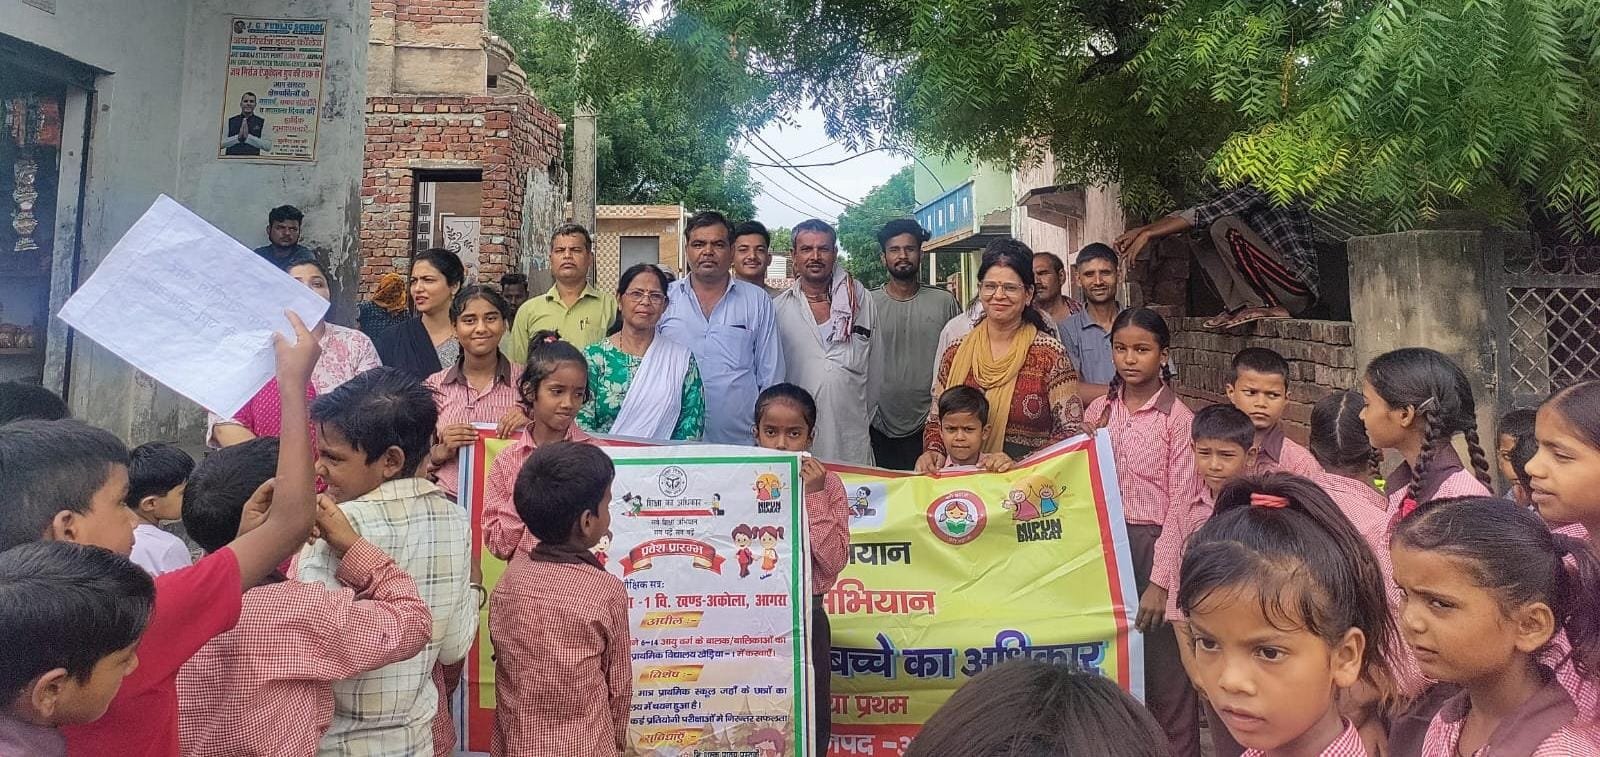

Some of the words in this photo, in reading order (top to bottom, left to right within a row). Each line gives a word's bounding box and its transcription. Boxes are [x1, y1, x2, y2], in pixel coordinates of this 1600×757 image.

[265, 22, 294, 31] PUBLIC
[295, 23, 324, 33] SCHOOL
[293, 67, 300, 78] की
[301, 89, 310, 97] को
[647, 498, 661, 507] शिक्षा
[677, 497, 701, 507] अधिकार
[758, 501, 781, 510] NIPUN
[1016, 519, 1062, 538] NIPUN
[1017, 531, 1062, 543] BHARAT
[641, 542, 666, 556] प्रवेश
[655, 592, 671, 608] वि.
[755, 594, 788, 607] आगरा
[647, 615, 682, 626] अपील
[660, 638, 677, 648] आयु
[679, 636, 693, 645] वर्ग
[695, 636, 704, 644] के
[631, 650, 664, 661] प्राथमिक
[665, 649, 696, 659] विद्यालय
[902, 648, 953, 677] का
[650, 670, 680, 678] विशेष
[658, 687, 690, 697] प्राथमिक
[695, 688, 716, 698] स्कूल
[720, 685, 737, 696] जहाँ
[741, 685, 750, 694] के
[754, 685, 772, 695] छात्रों
[644, 702, 652, 710] में
[673, 702, 689, 713] हुआ
[856, 695, 909, 718] प्रथम
[646, 714, 680, 725] प्रतियोगी
[682, 713, 715, 723] परीक्षाओं
[725, 713, 755, 723] निरन्तर
